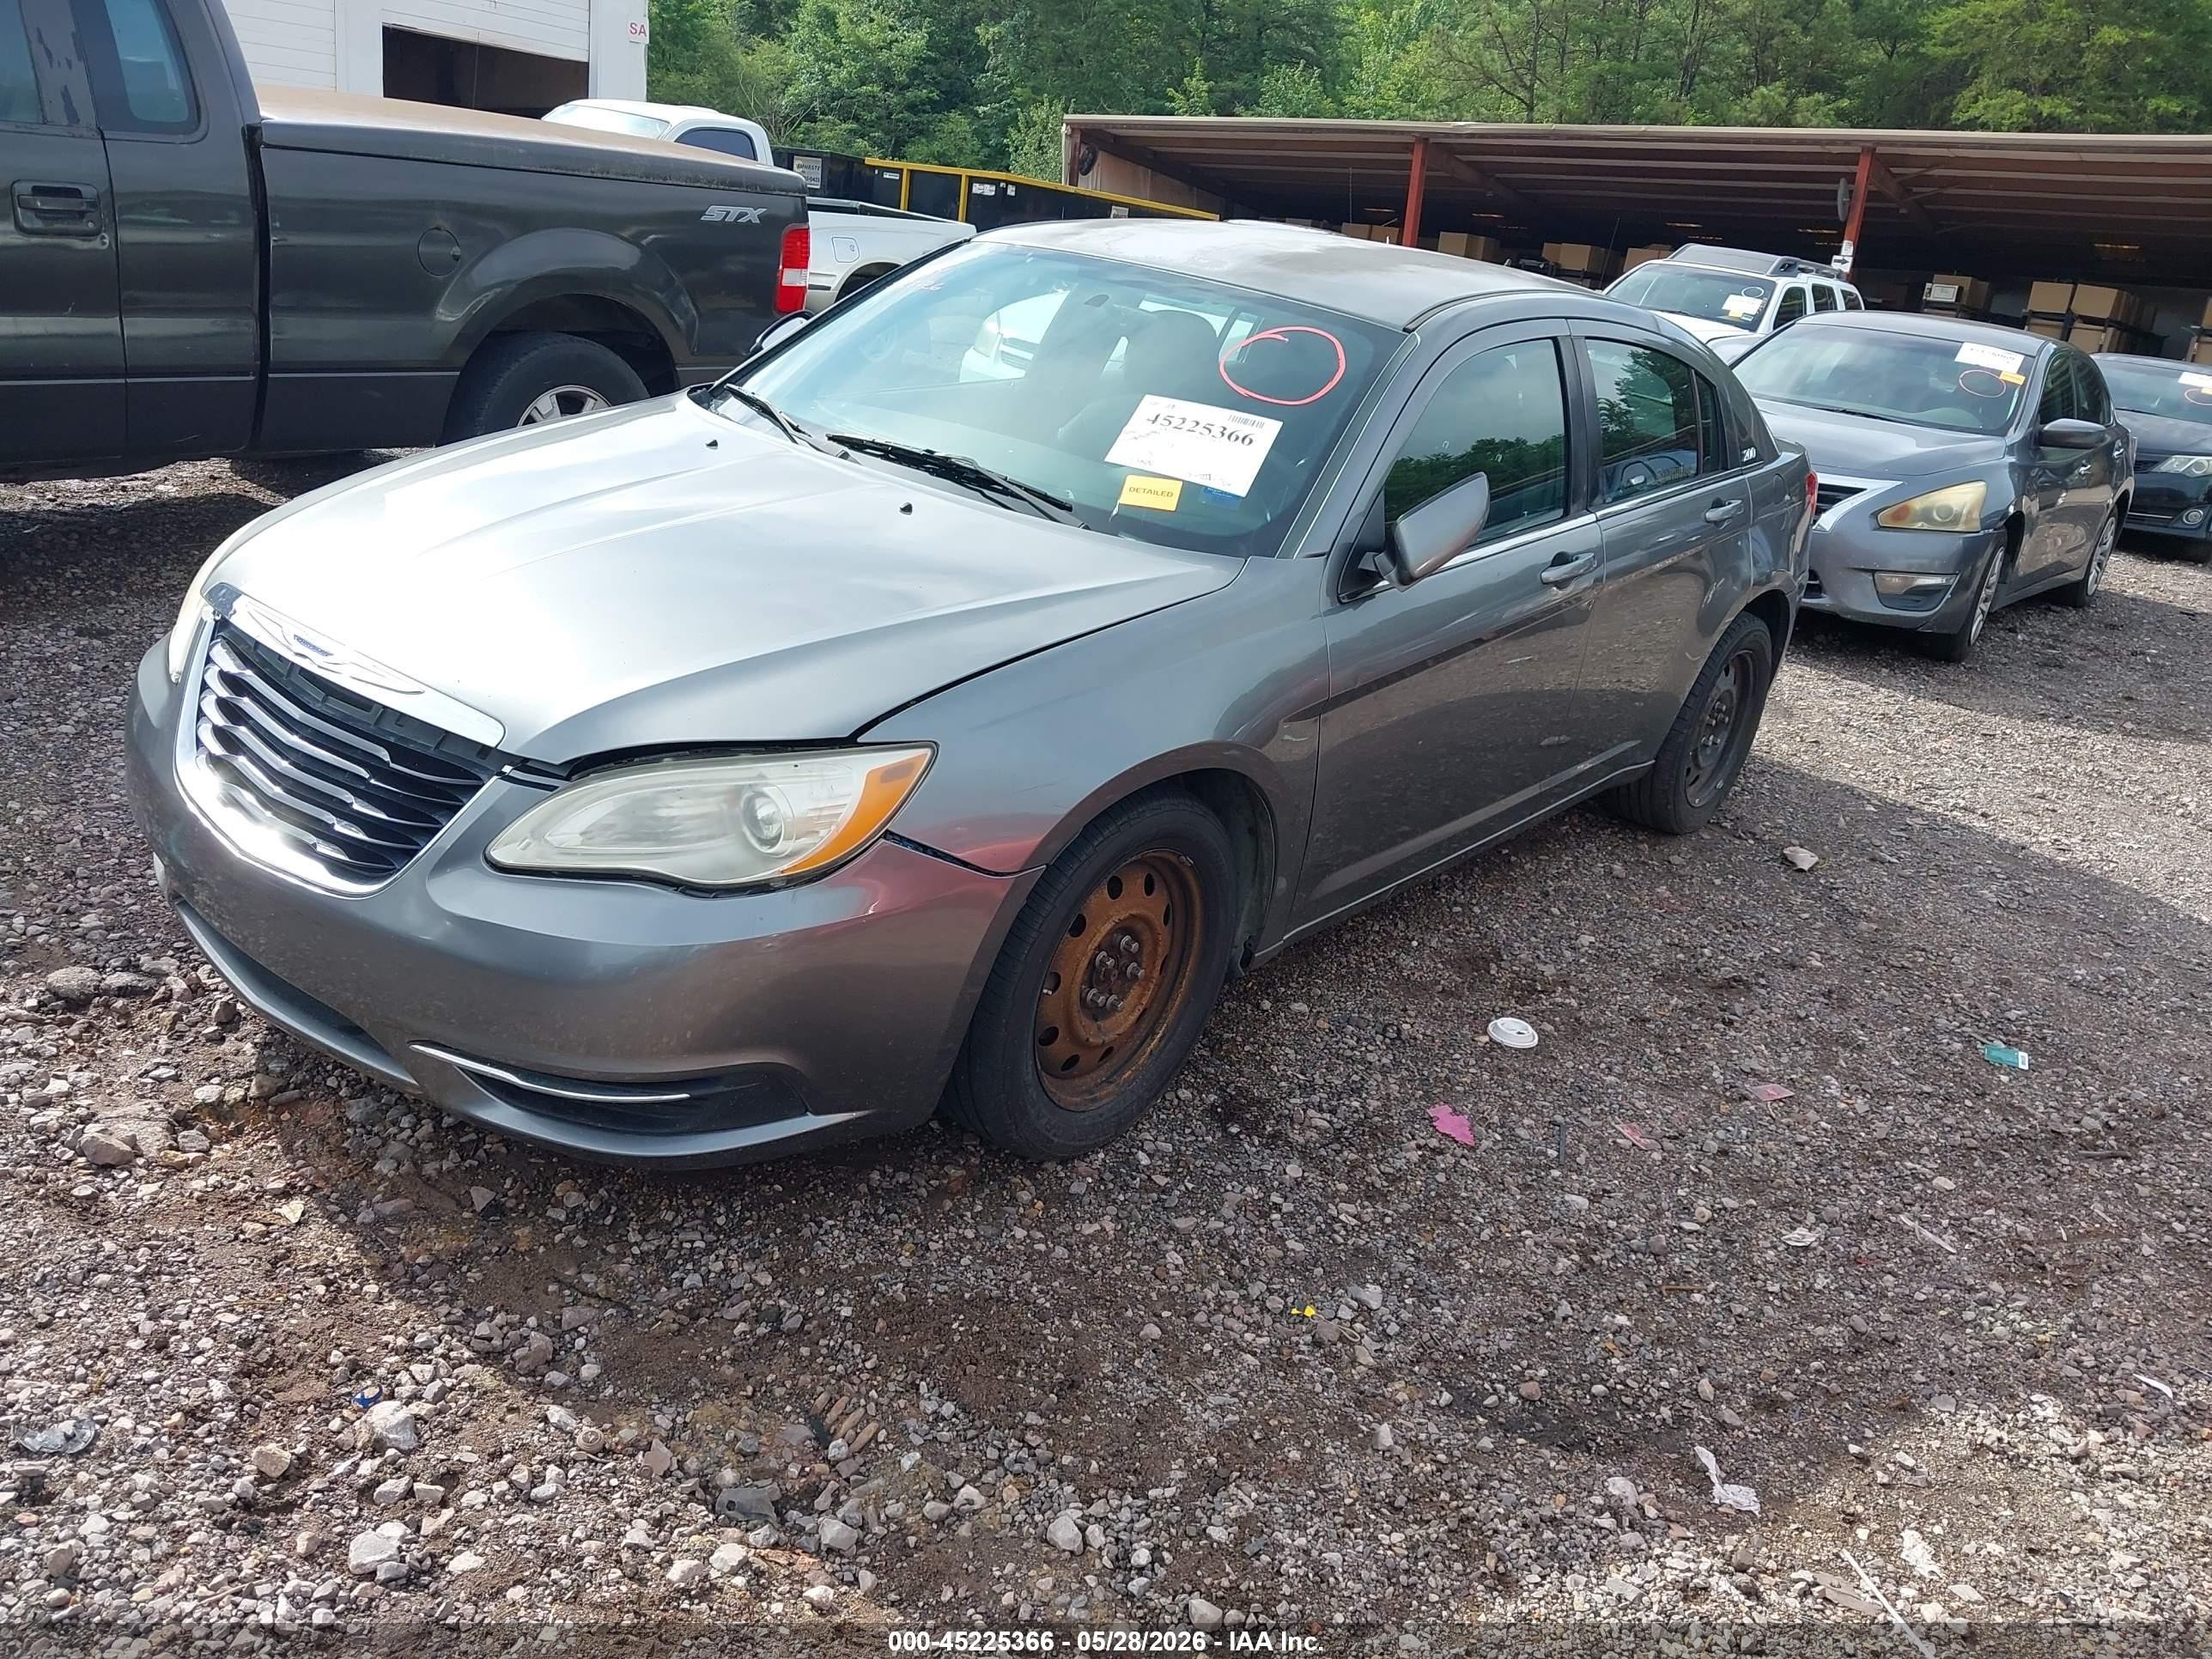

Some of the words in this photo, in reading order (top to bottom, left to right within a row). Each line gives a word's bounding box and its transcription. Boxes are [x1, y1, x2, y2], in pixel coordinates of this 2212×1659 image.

[629, 21, 647, 37] SA
[701, 205, 768, 223] STX
[1146, 413, 1255, 447] 45225366
[1128, 486, 1175, 498] DETAILED
